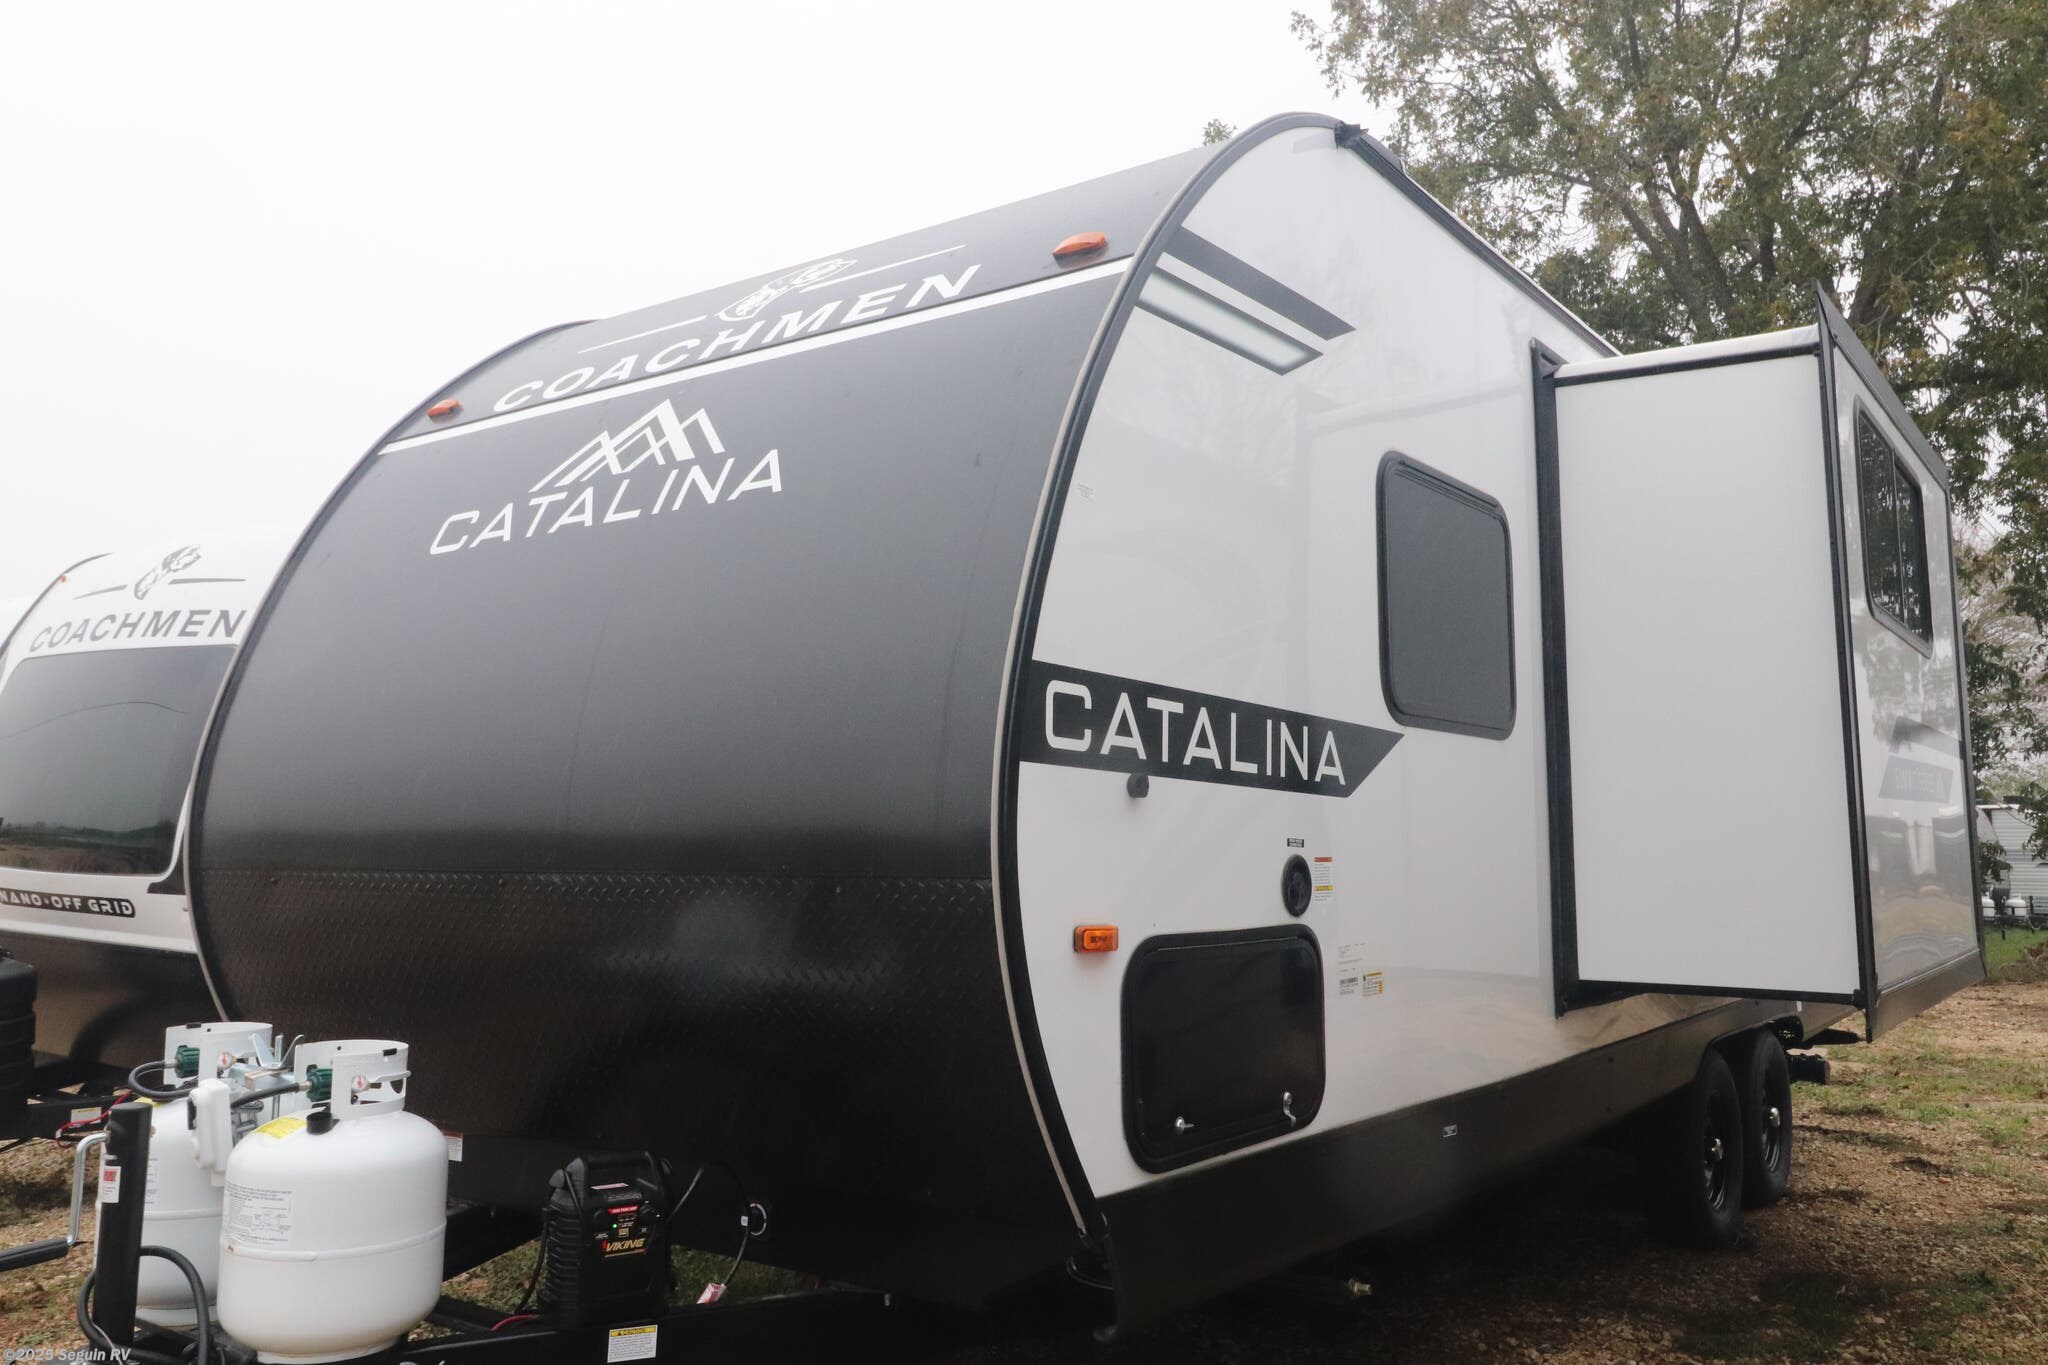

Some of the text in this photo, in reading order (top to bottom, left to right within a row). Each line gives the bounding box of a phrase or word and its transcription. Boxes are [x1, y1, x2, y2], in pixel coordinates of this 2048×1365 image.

[492, 263, 983, 413] COACHMEN
[428, 448, 784, 556] CATALINA
[29, 609, 247, 654] COACHMEN
[1044, 679, 1347, 786] CATALINA
[88, 898, 133, 915] GRID
[605, 1237, 647, 1252] VIKING
